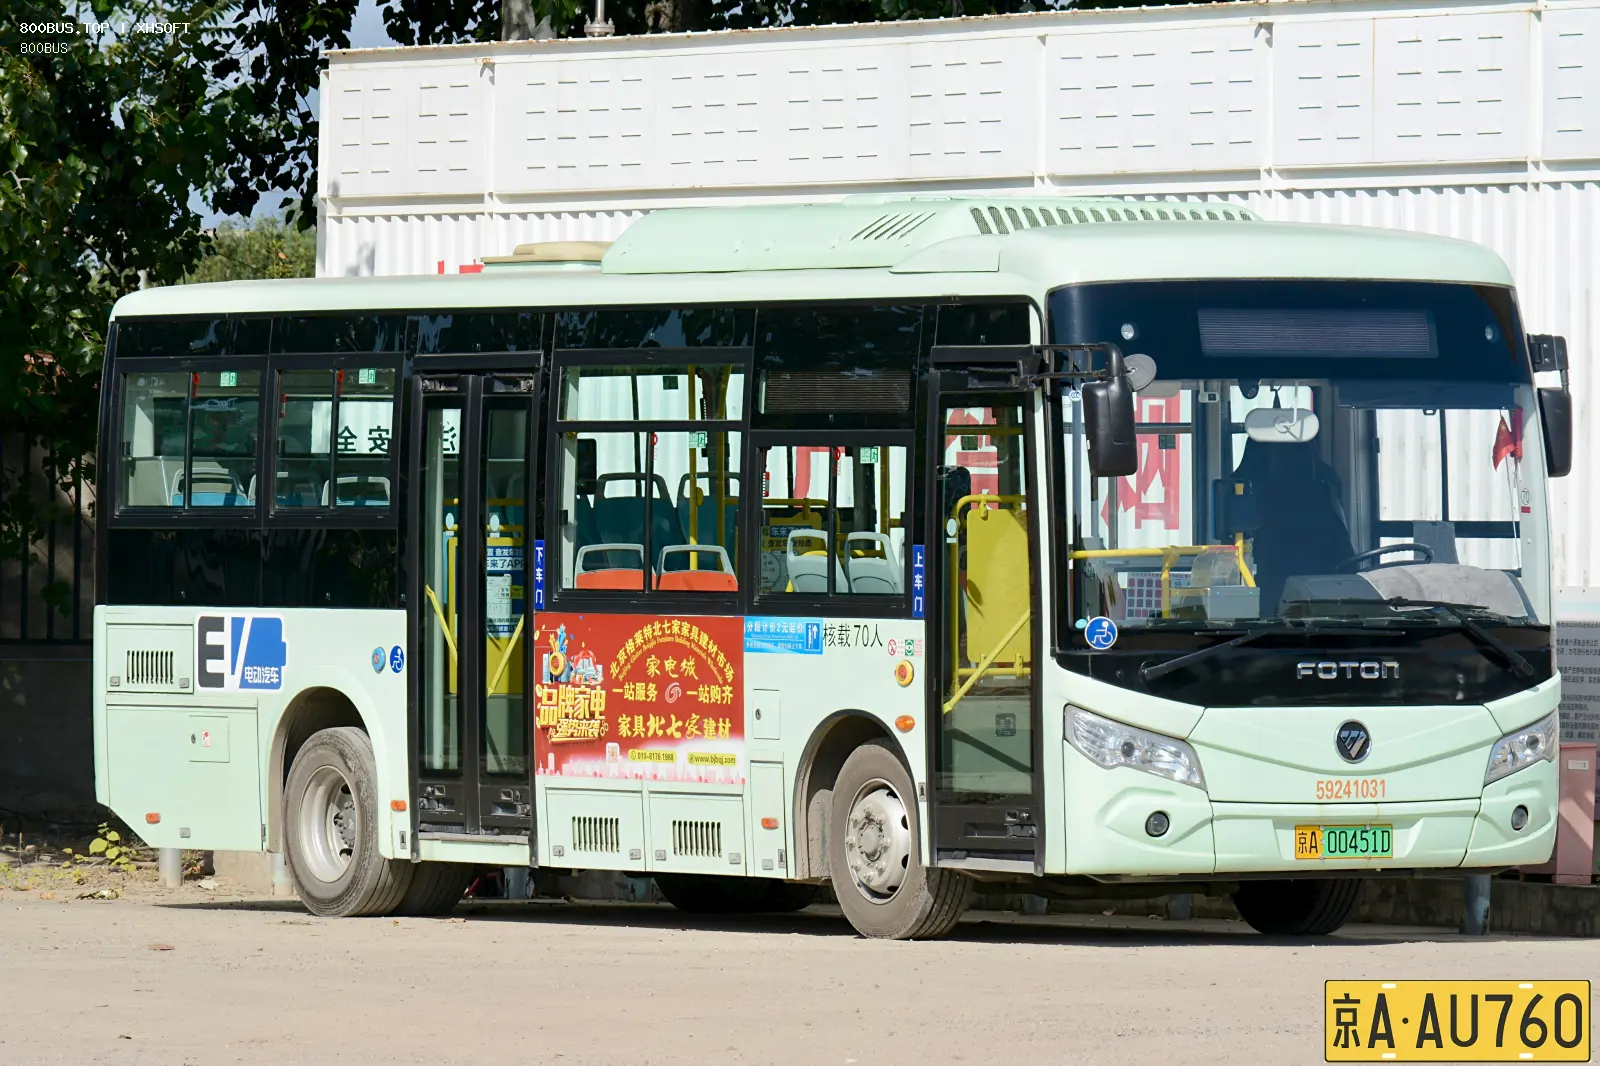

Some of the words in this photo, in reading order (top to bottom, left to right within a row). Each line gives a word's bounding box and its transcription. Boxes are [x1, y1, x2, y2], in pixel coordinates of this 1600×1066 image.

[535, 547, 544, 604] 下车门
[914, 552, 924, 612] 上车门
[823, 623, 883, 647] 核载70人
[244, 666, 280, 684] 电动汽车
[646, 655, 698, 680] 家电城
[1297, 661, 1400, 680] FOTON
[540, 684, 606, 726] 品牌家电
[612, 682, 658, 702] 一站服务
[686, 684, 734, 704] 一站购齐
[618, 713, 731, 740] 家具北七家建材
[1316, 779, 1386, 800] 59241031
